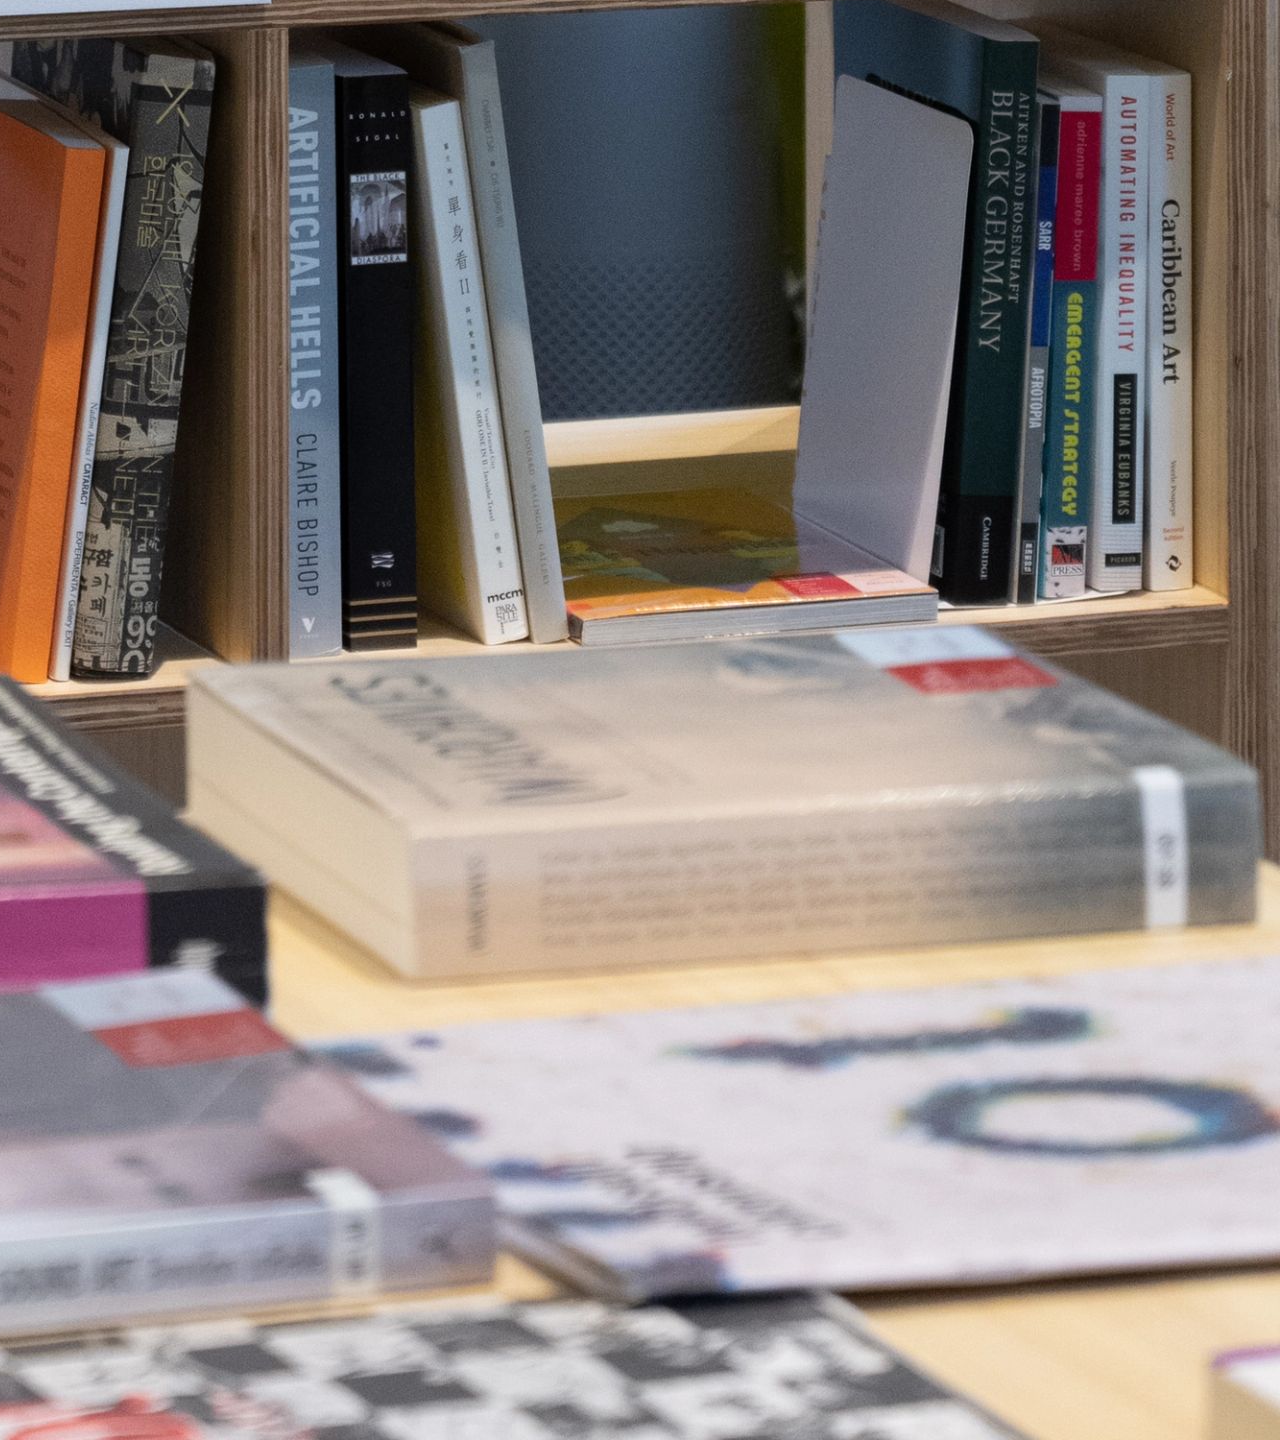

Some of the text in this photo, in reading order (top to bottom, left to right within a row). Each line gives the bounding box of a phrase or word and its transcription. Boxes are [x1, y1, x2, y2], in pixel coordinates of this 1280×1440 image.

[288, 102, 324, 409] ARTIFICIAL HELLS
[979, 91, 1011, 351] BLACK GERMANY
[1118, 96, 1136, 351] AUTOMATING INEQUALITY
[1162, 199, 1181, 382] Caribbean Art
[296, 434, 318, 595] CLAIRE BISHOP
[1059, 291, 1084, 517] EMERGENT STRATEGY
